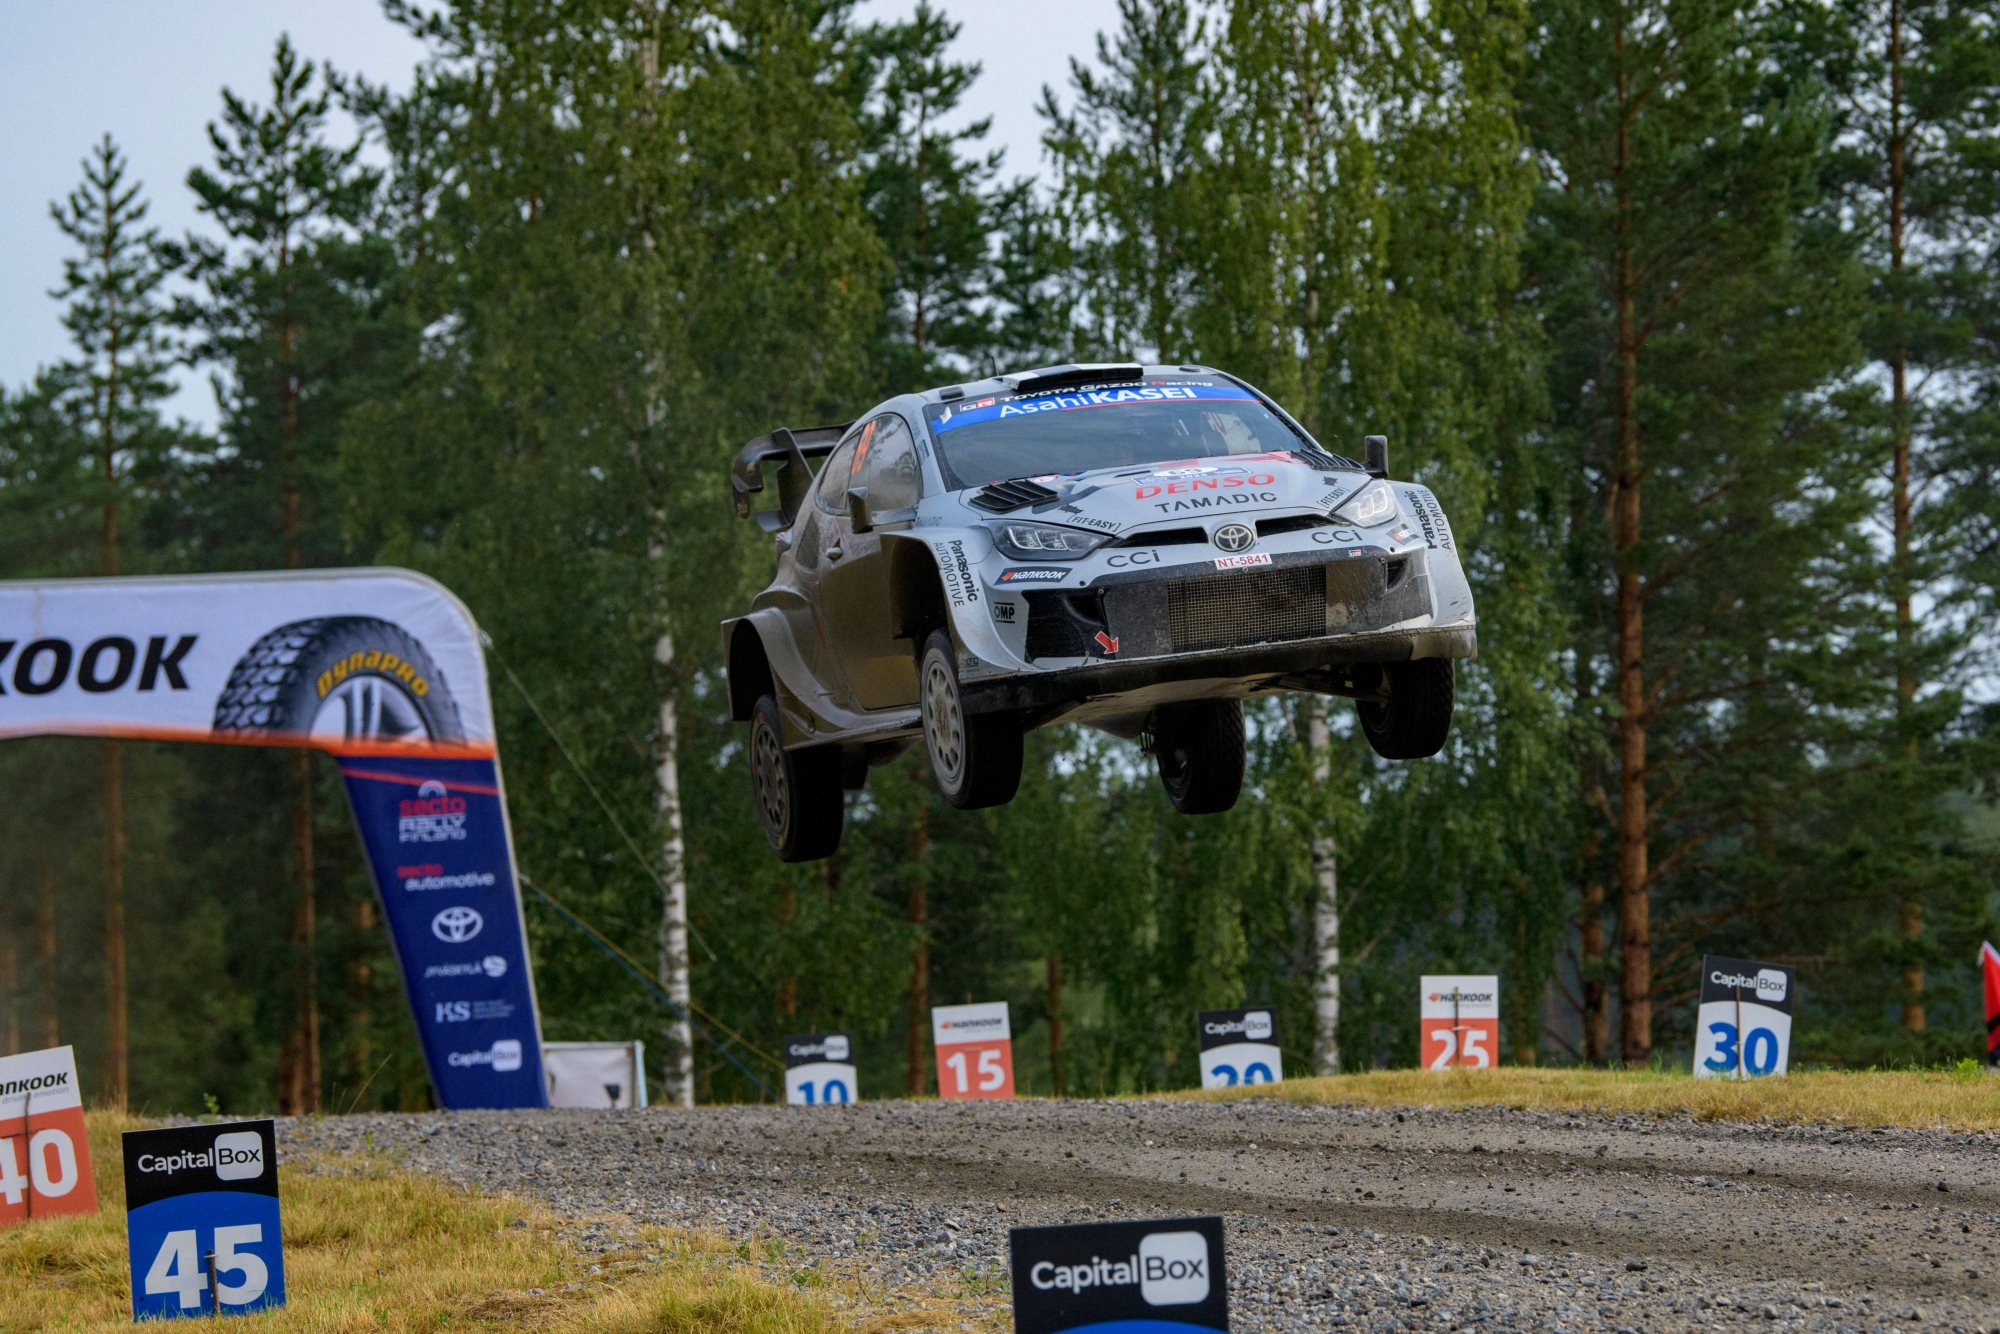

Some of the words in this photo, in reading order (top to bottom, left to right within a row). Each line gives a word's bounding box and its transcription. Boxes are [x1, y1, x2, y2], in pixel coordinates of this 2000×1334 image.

[1000, 387, 1076, 402] TOYOTA
[1135, 474, 1275, 500] DENSO
[1154, 492, 1277, 513] TAMADIC
[1404, 490, 1437, 550] Panasonic
[1417, 489, 1451, 550] AUTOMOTIVE
[948, 539, 978, 602] Panasonic
[1217, 553, 1269, 568] NT-5841
[933, 542, 965, 607] AUTOMOTIVE
[994, 606, 1015, 620] OMP
[405, 871, 495, 891] automotive
[436, 1001, 471, 1022] KS
[1431, 1029, 1489, 1070] 25
[1703, 1022, 1778, 1077] 30
[946, 1050, 1005, 1093] 15
[33, 1086, 69, 1099] emotion
[798, 1080, 849, 1104] 10
[145, 1223, 268, 1309] 45
